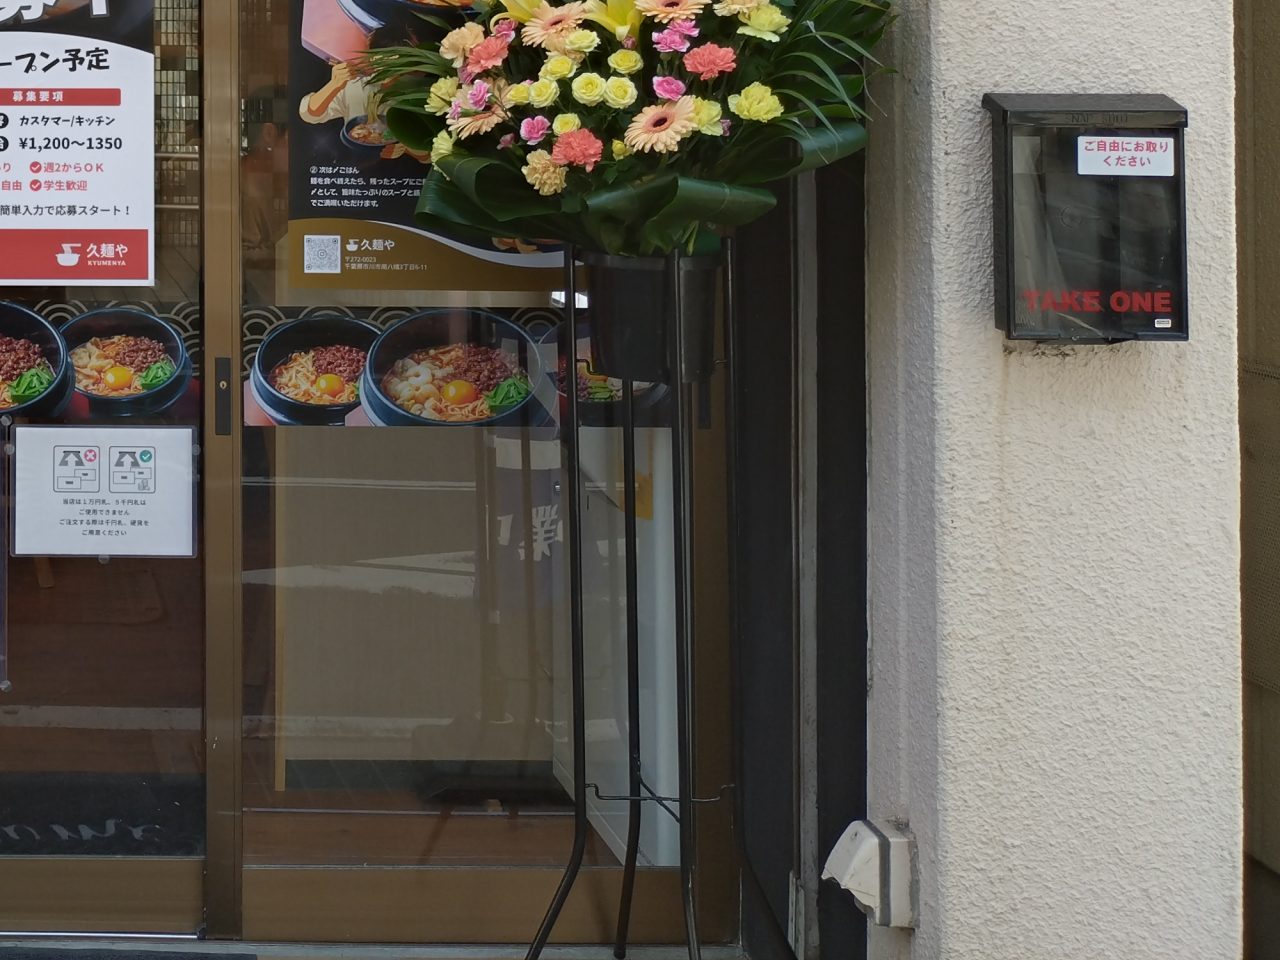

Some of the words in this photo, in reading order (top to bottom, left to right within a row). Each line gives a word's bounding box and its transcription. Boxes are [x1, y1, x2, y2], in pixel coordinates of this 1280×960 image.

[13, 91, 64, 102] 募集要項
[19, 115, 115, 127] カスタマー/キッチン
[1084, 140, 1169, 153] ご自由にお取り
[1103, 155, 1151, 167] ください
[44, 180, 88, 191] 学生歓迎
[87, 243, 128, 258] 久麺や
[360, 239, 395, 251] 久麺や
[1024, 290, 1102, 312] TAKE
[1109, 291, 1172, 313] ONE
